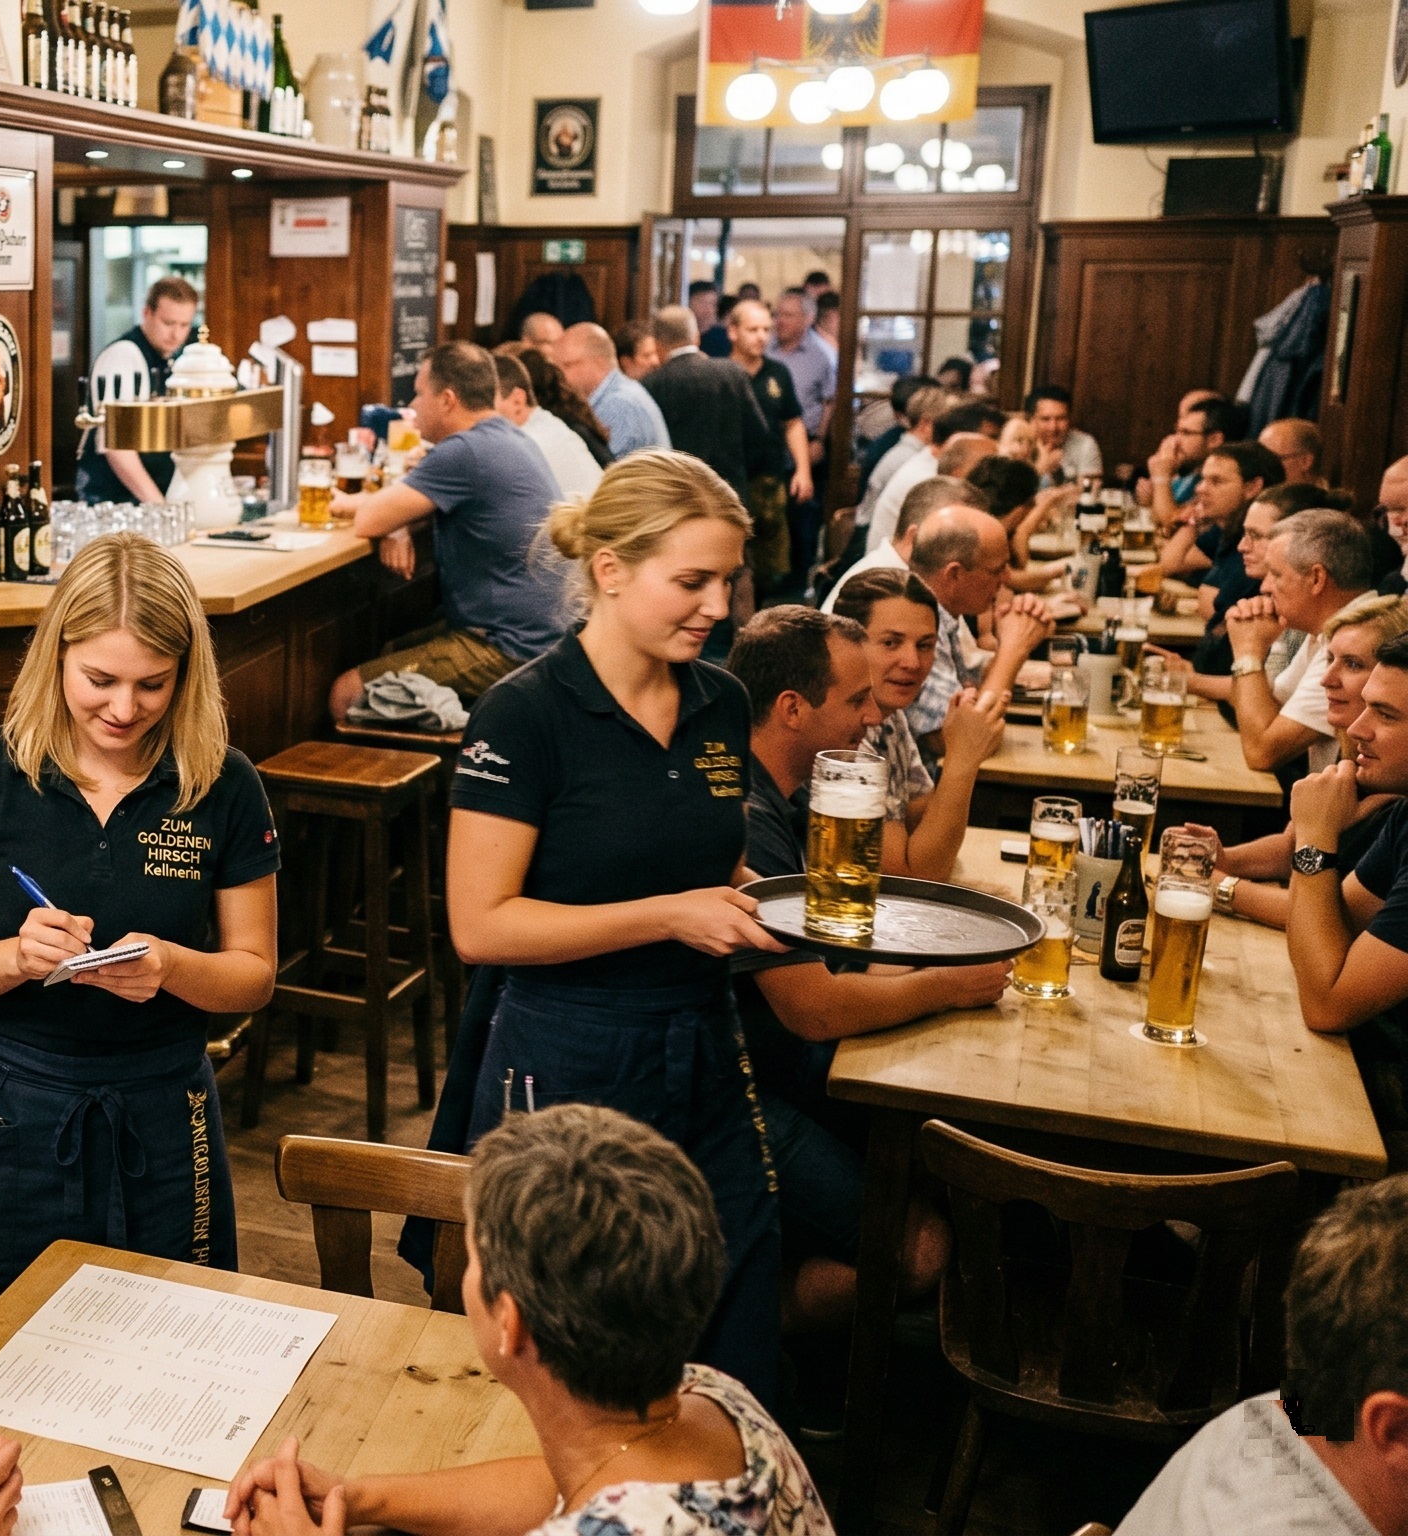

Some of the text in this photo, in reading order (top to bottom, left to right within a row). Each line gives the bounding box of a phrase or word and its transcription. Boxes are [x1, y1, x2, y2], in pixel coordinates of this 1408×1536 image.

[160, 818, 192, 833] ZUM
[137, 831, 211, 850] GOLDENEN
[148, 847, 200, 864] HIRSCH
[144, 862, 200, 880] Kellnerin
